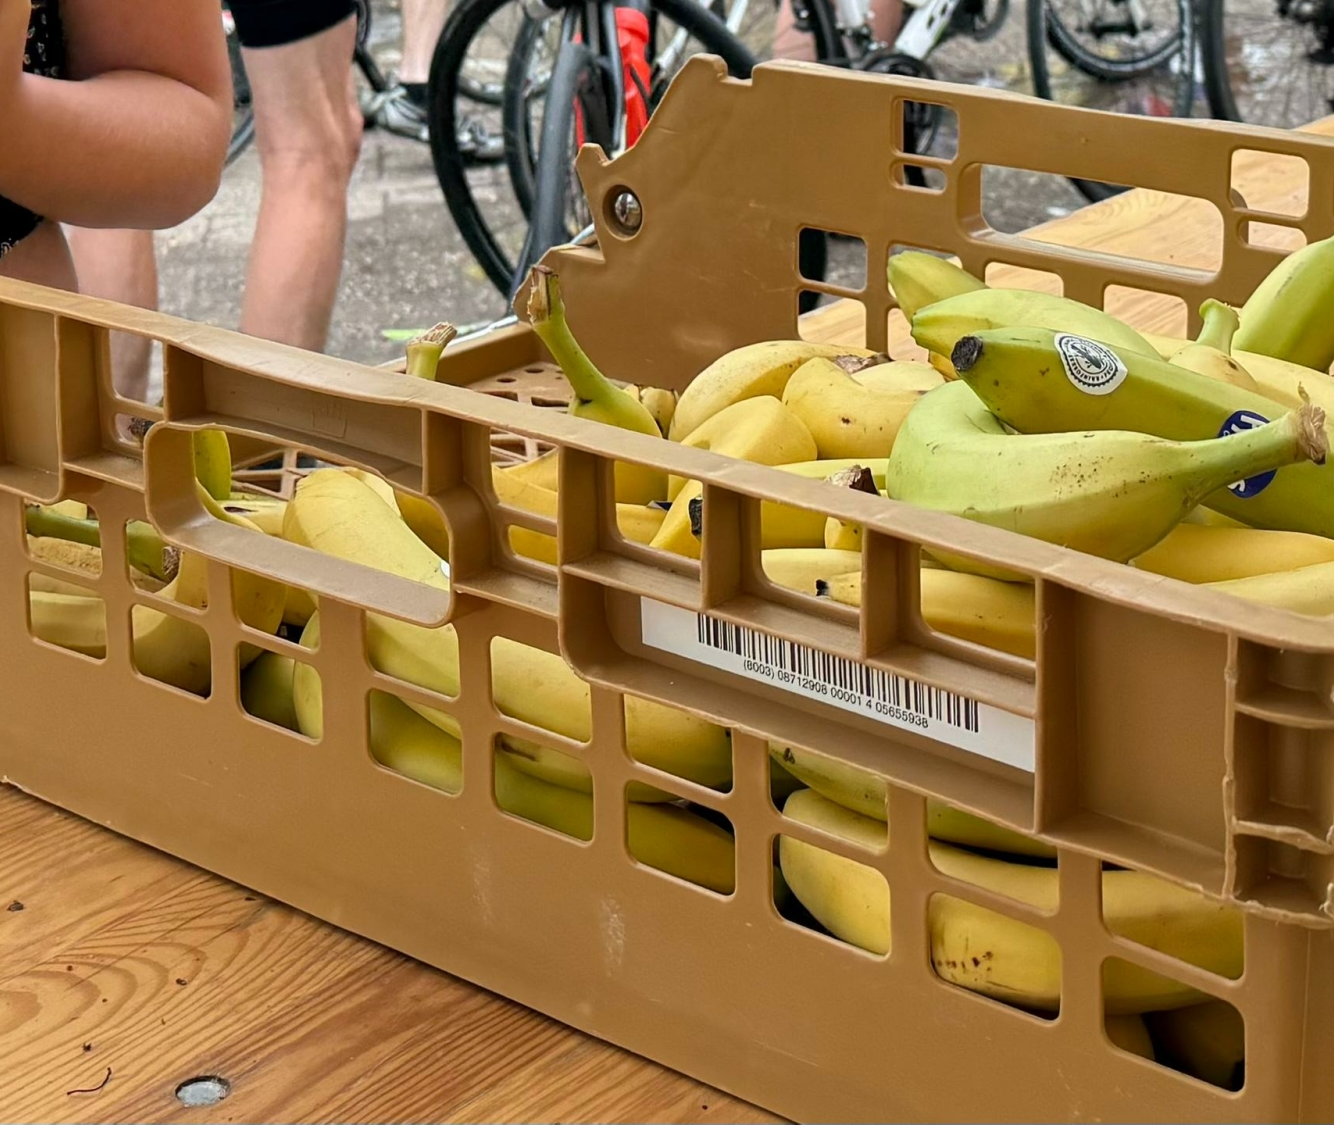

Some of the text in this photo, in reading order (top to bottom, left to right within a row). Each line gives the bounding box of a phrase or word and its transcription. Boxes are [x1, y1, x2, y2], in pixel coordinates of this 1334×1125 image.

[743, 659, 929, 729] (8003) 08712908 00001 4 05655938
